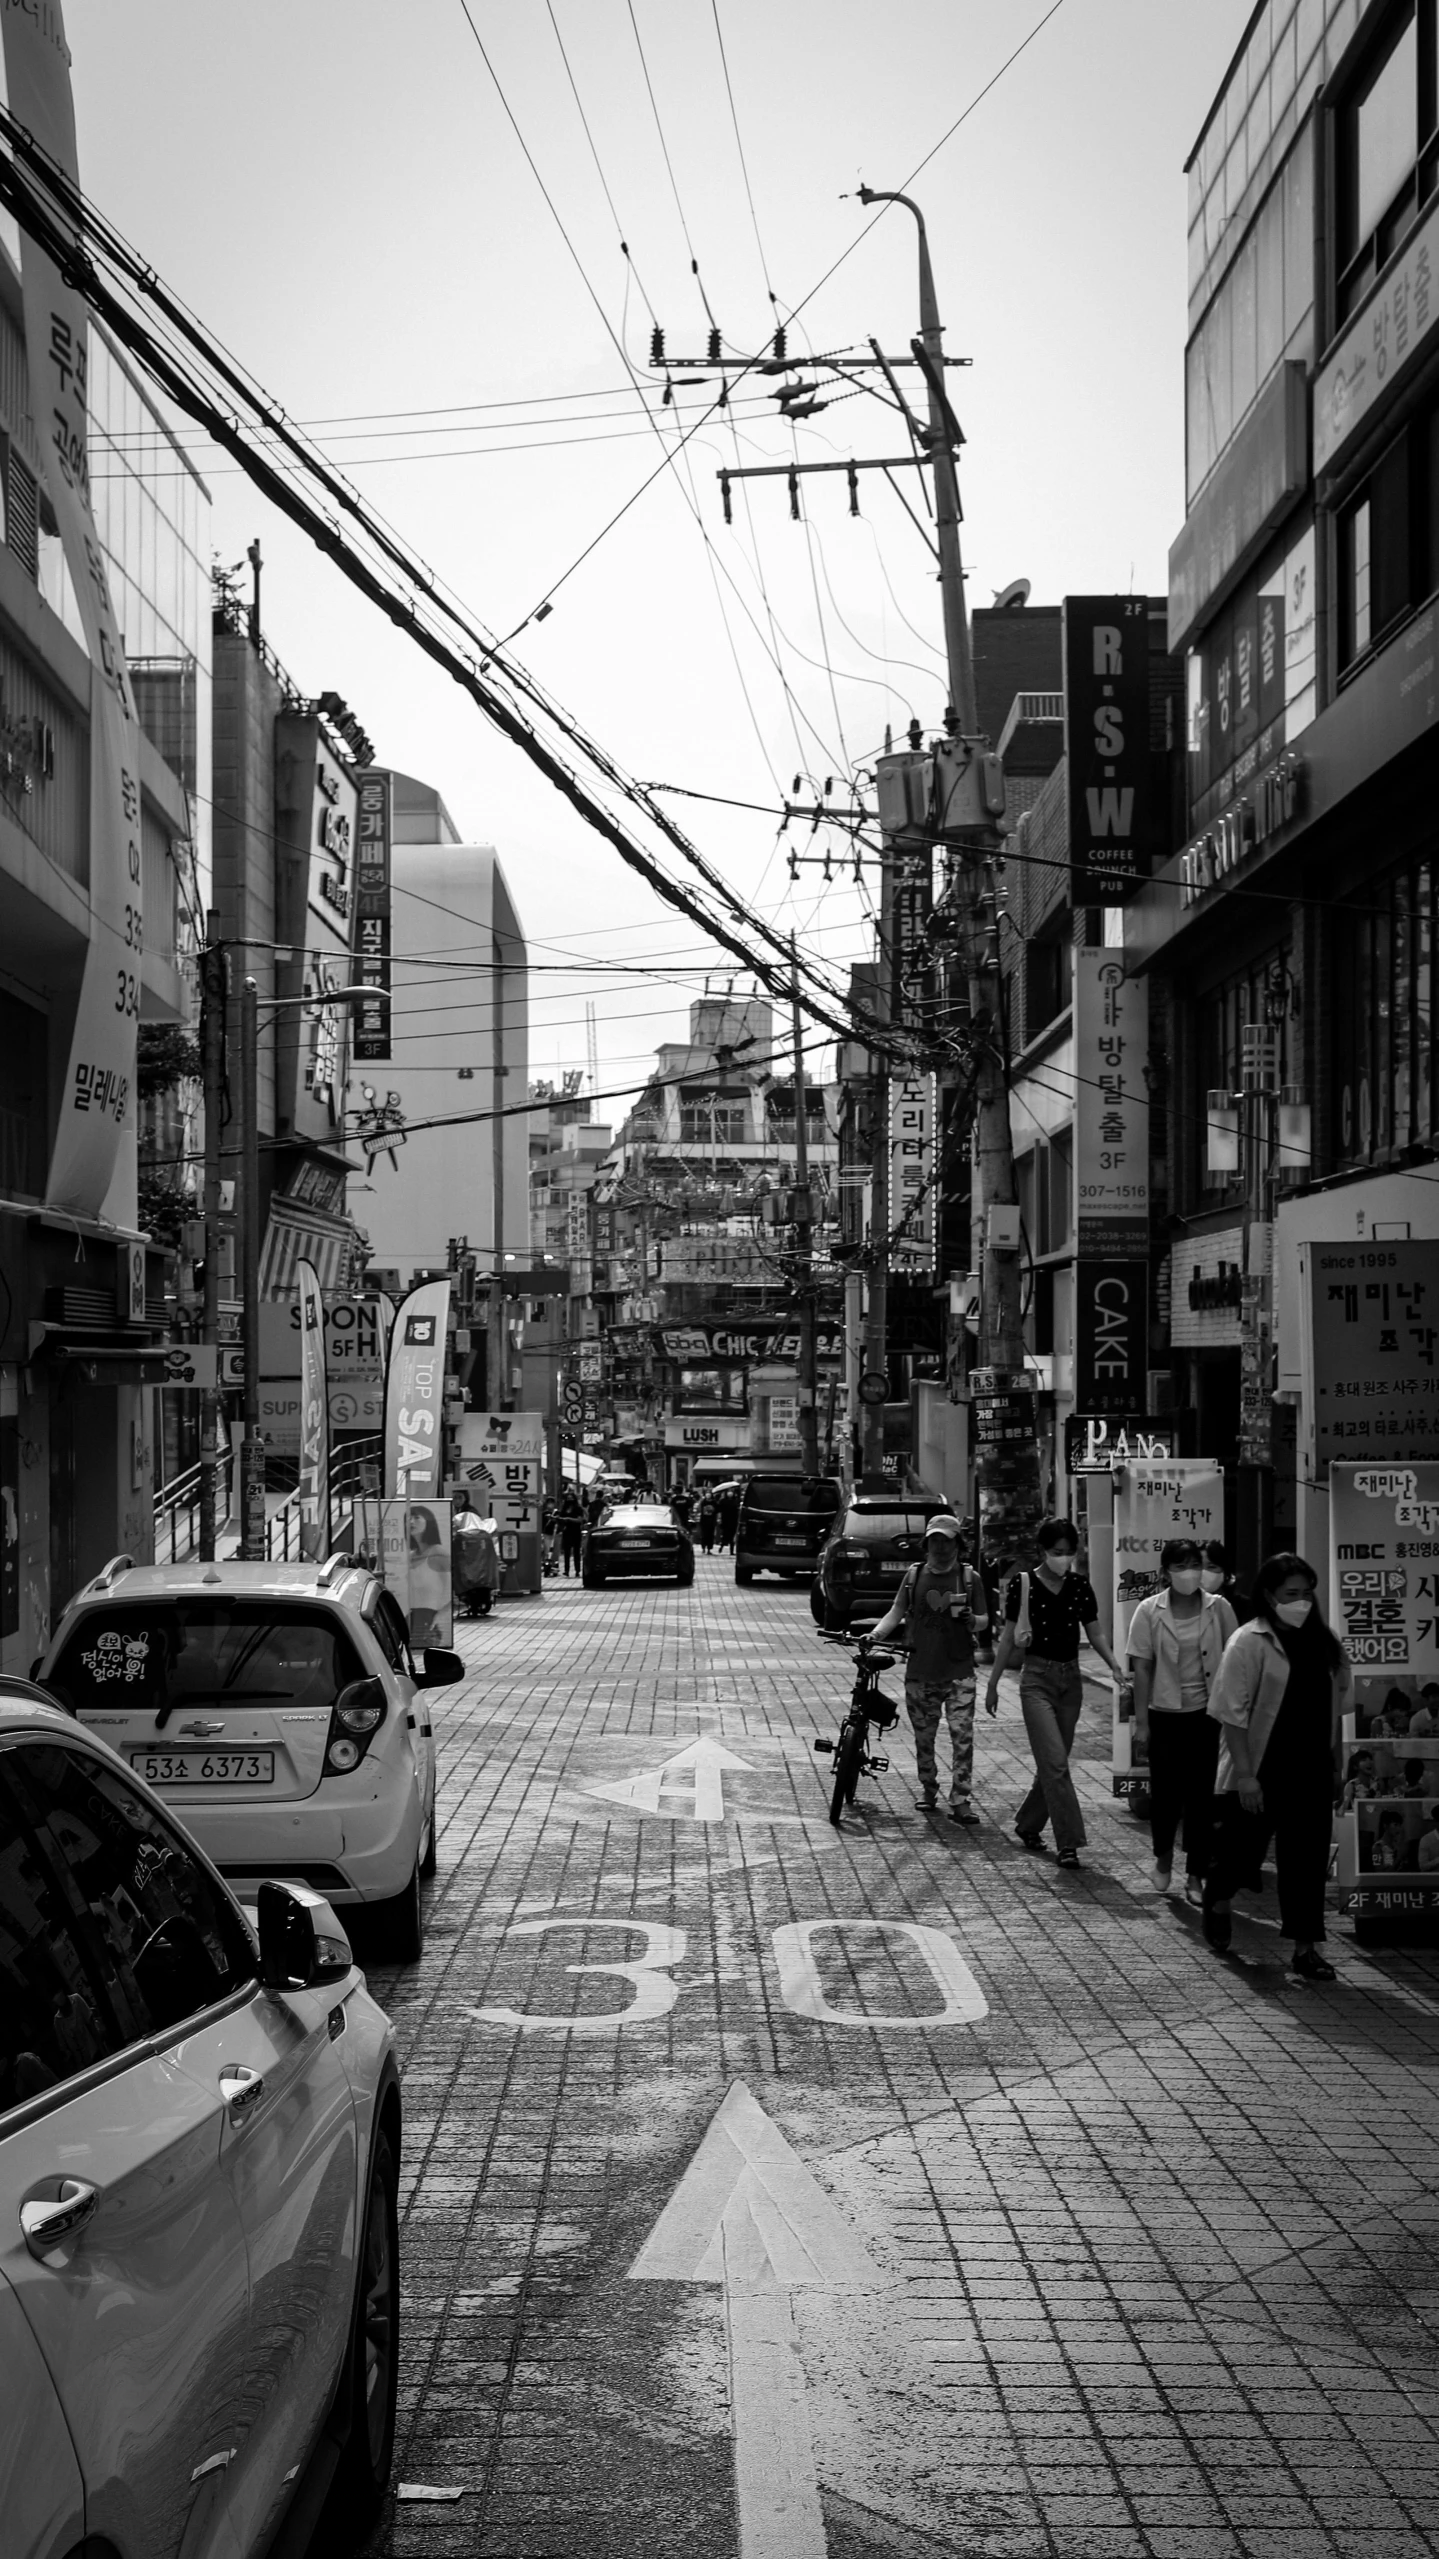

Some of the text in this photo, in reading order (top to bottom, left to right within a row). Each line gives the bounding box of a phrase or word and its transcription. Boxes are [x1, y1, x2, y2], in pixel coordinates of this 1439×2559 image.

[1124, 604, 1143, 616] 2F
[1088, 849, 1134, 860] COFFEE
[1099, 880, 1124, 891] PUB
[364, 1044, 381, 1056] 3F
[1098, 1036, 1127, 1143] 방탈출
[1099, 1153, 1127, 1170] 3F
[1079, 1185, 1147, 1198] 307-1516
[899, 1165, 926, 1240] 룸카페
[900, 1253, 923, 1264] 4F
[1320, 1252, 1397, 1269] since 1995
[1328, 1282, 1426, 1322] 재미난
[413, 1321, 432, 1341] 10
[1093, 1277, 1129, 1380] CAKE
[331, 1339, 354, 1357] 5F
[1378, 1328, 1438, 1366] 조각
[415, 1364, 434, 1399] TOP
[1011, 1374, 1030, 1388] 2층
[1333, 1381, 1360, 1397] 홍대
[1363, 1380, 1389, 1396] 원조
[1392, 1379, 1419, 1395] 사주
[683, 1427, 719, 1442] LUSH
[1332, 1420, 1370, 1438] 최고의
[1136, 1481, 1183, 1503] 재미난
[1358, 1474, 1413, 1500] 재미난
[1171, 1508, 1212, 1529] 조각가
[1341, 1571, 1386, 1597] 우리
[1342, 1599, 1406, 1635] 결혼
[1341, 1637, 1408, 1663] 했어요
[81, 1650, 123, 1669] 정신이
[145, 1756, 260, 1779] 53소 6373
[1119, 1780, 1136, 1793] 2F
[1347, 1892, 1370, 1908] 2F
[1375, 1891, 1426, 1909] 재미난
